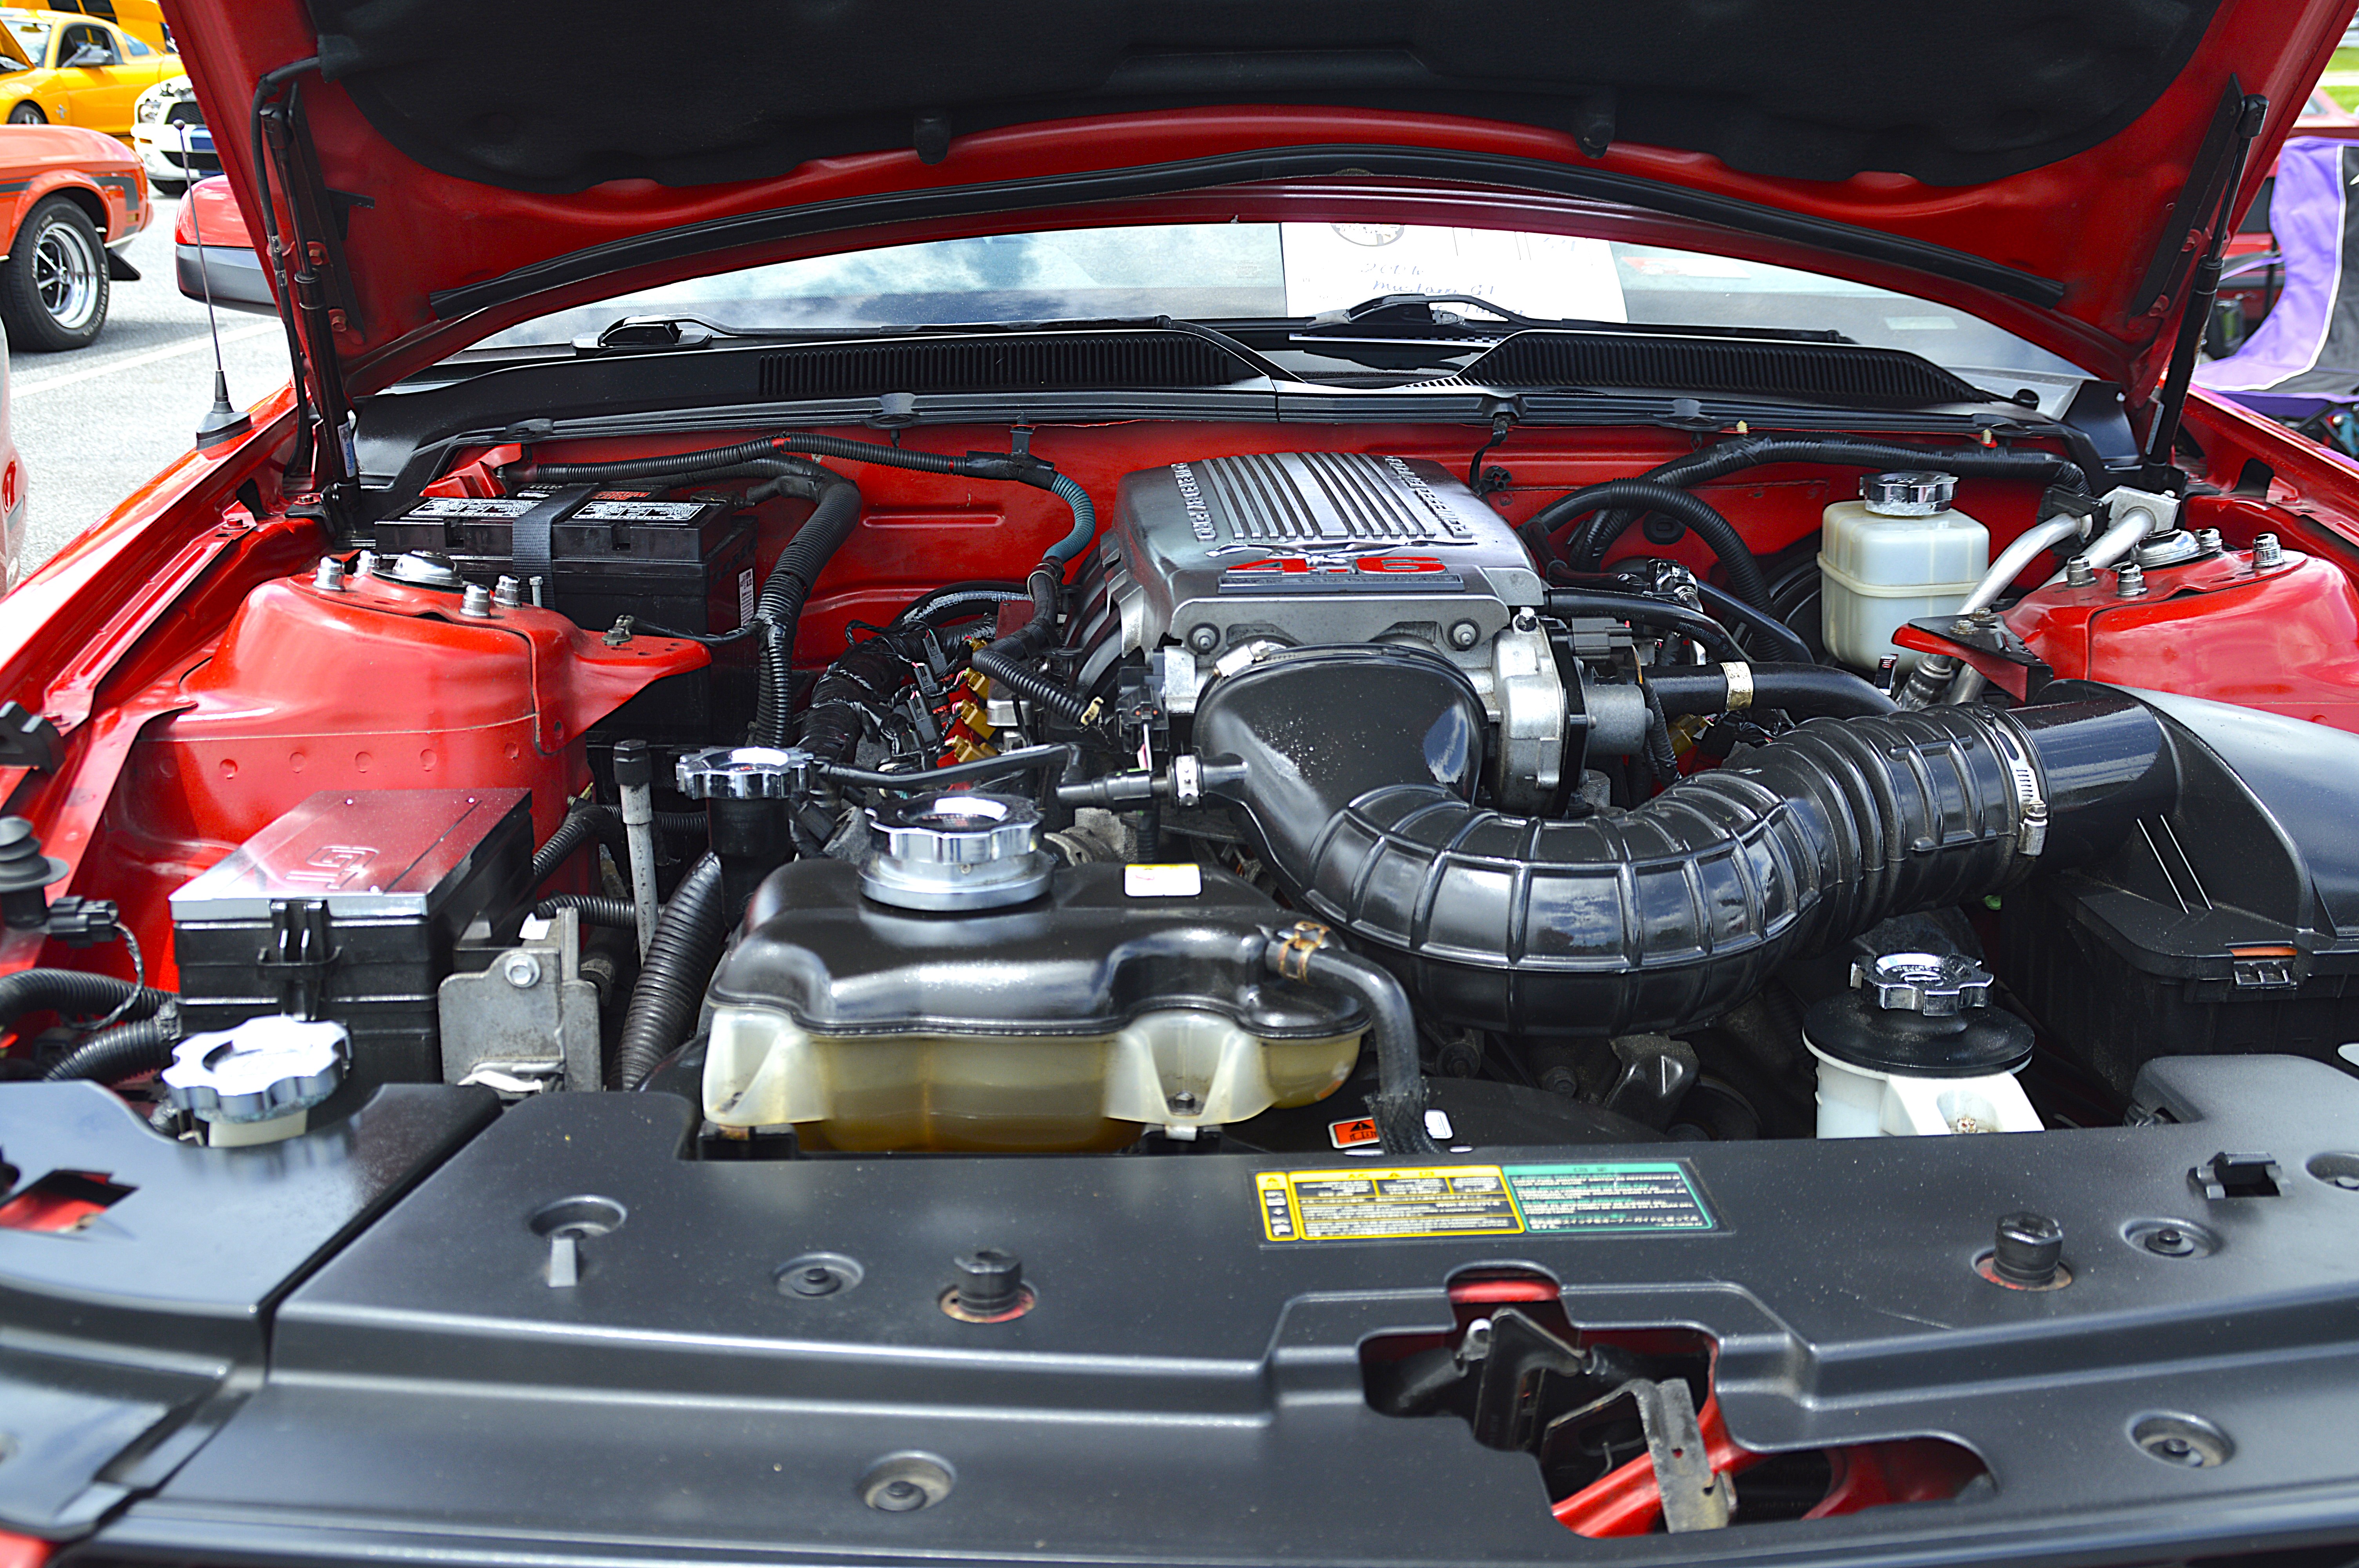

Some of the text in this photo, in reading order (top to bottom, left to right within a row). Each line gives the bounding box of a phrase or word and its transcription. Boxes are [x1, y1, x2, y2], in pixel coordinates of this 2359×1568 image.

[1185, 496, 1207, 511] BY
[1188, 510, 1216, 541] FORD
[1224, 556, 1449, 575] 4.6
